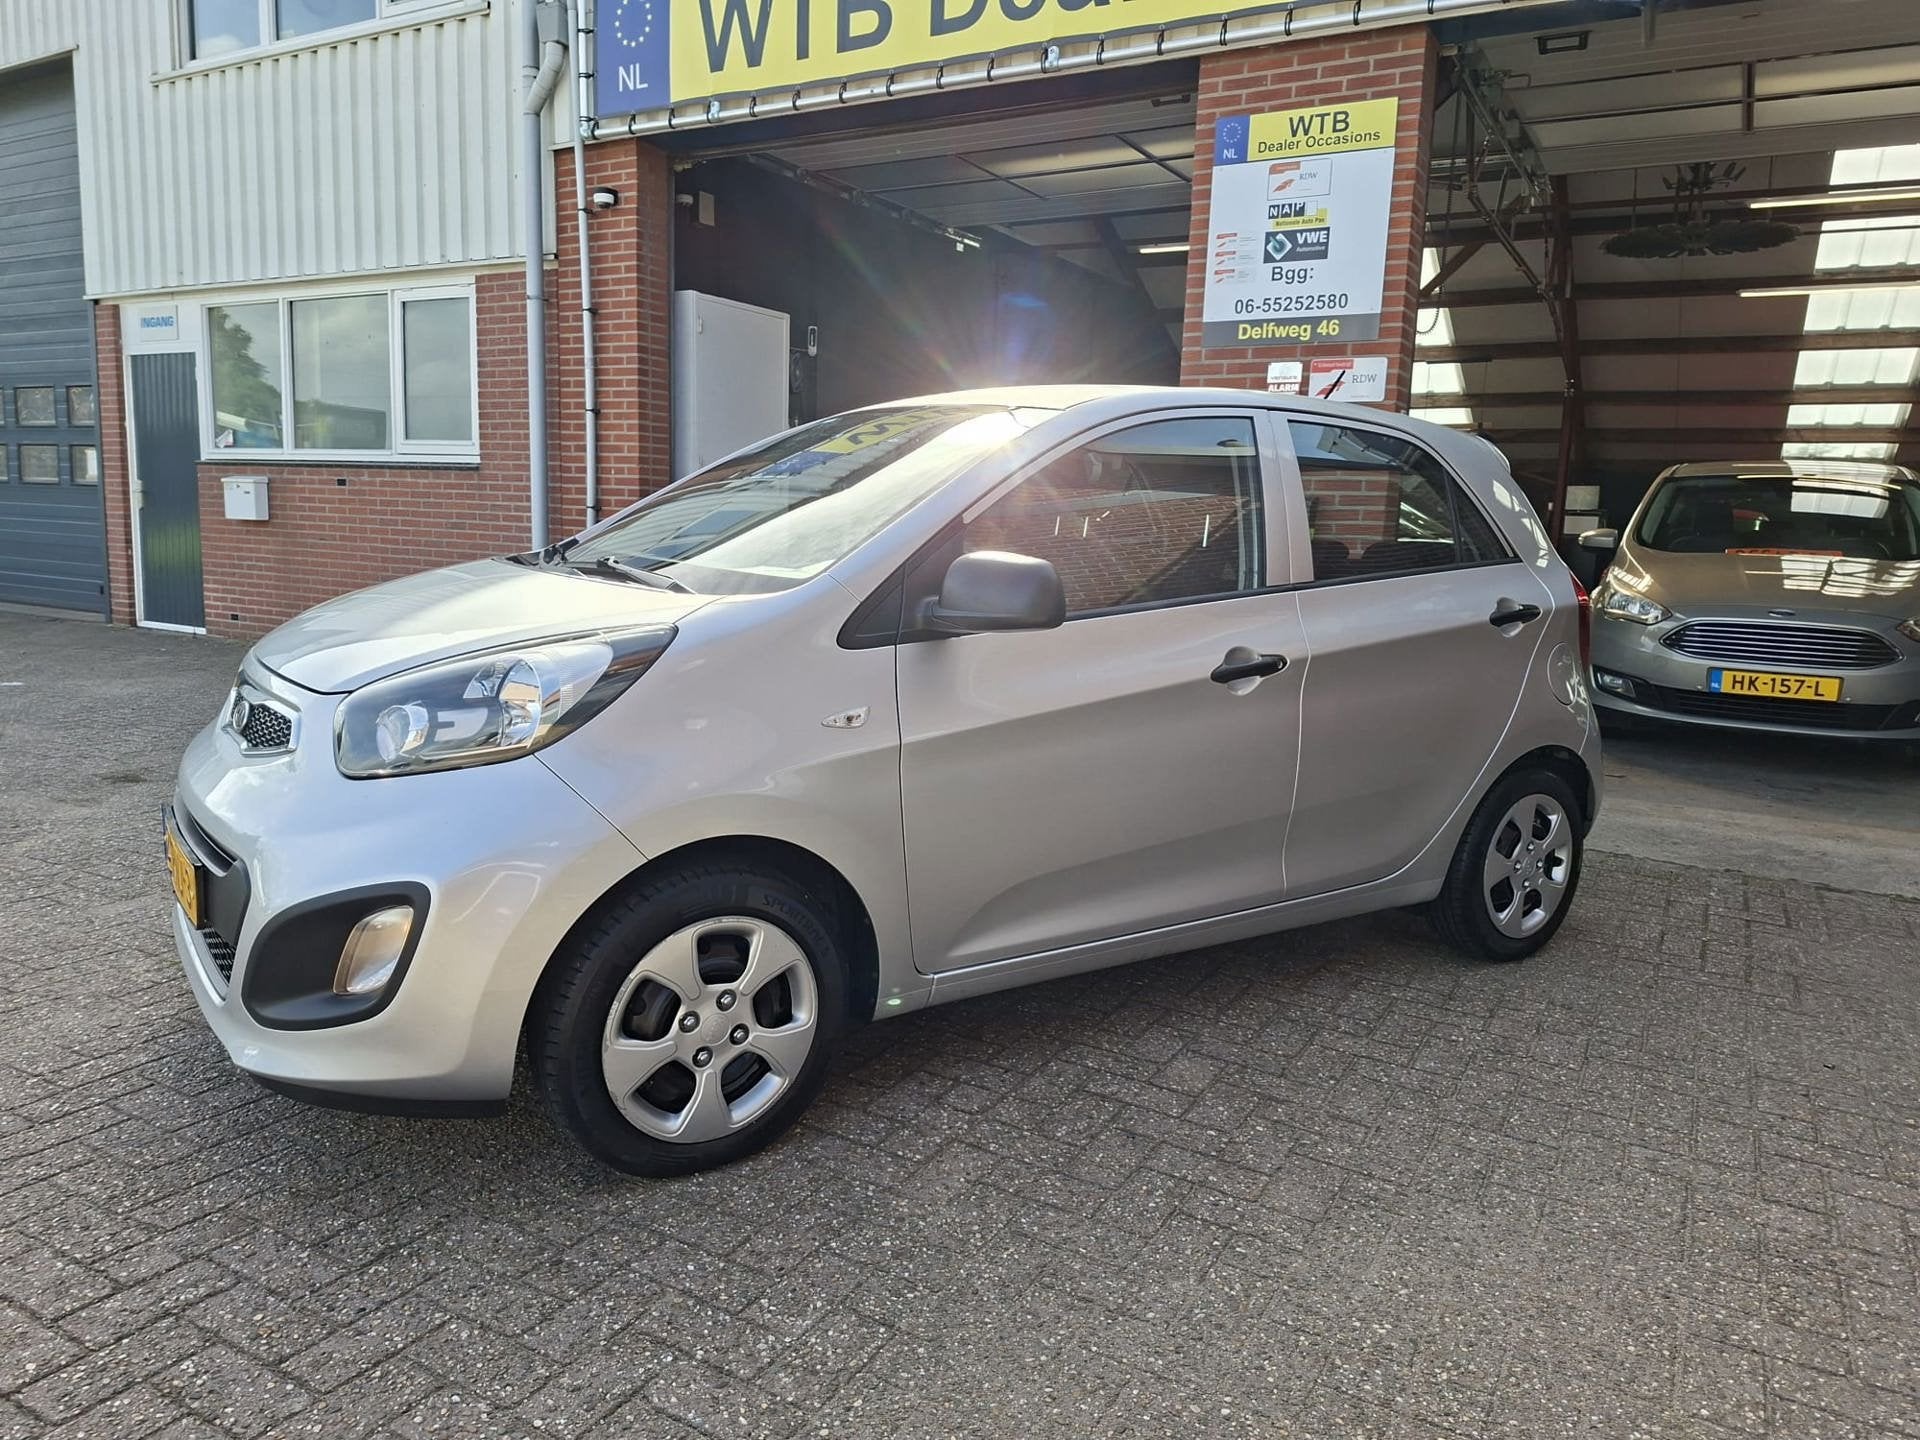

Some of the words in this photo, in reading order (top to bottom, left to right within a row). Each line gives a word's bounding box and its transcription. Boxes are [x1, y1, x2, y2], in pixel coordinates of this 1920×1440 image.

[618, 62, 648, 92] NL
[1289, 110, 1350, 138] WTB
[1257, 139, 1301, 154] Dealer
[1305, 129, 1381, 149] Occasions
[1223, 147, 1238, 160] NL
[1269, 202, 1304, 218] NAP
[1301, 217, 1314, 225] Auto
[1296, 231, 1328, 245] VWE
[1271, 266, 1315, 285] Bgg:
[1234, 293, 1349, 315] 06-55252580
[140, 316, 174, 328] INGANG
[1237, 322, 1312, 341] Delfweg
[1316, 319, 1341, 337] 46
[1352, 374, 1378, 384] RDW
[1268, 383, 1299, 393] ALARM
[1731, 674, 1826, 697] HK-157-L
